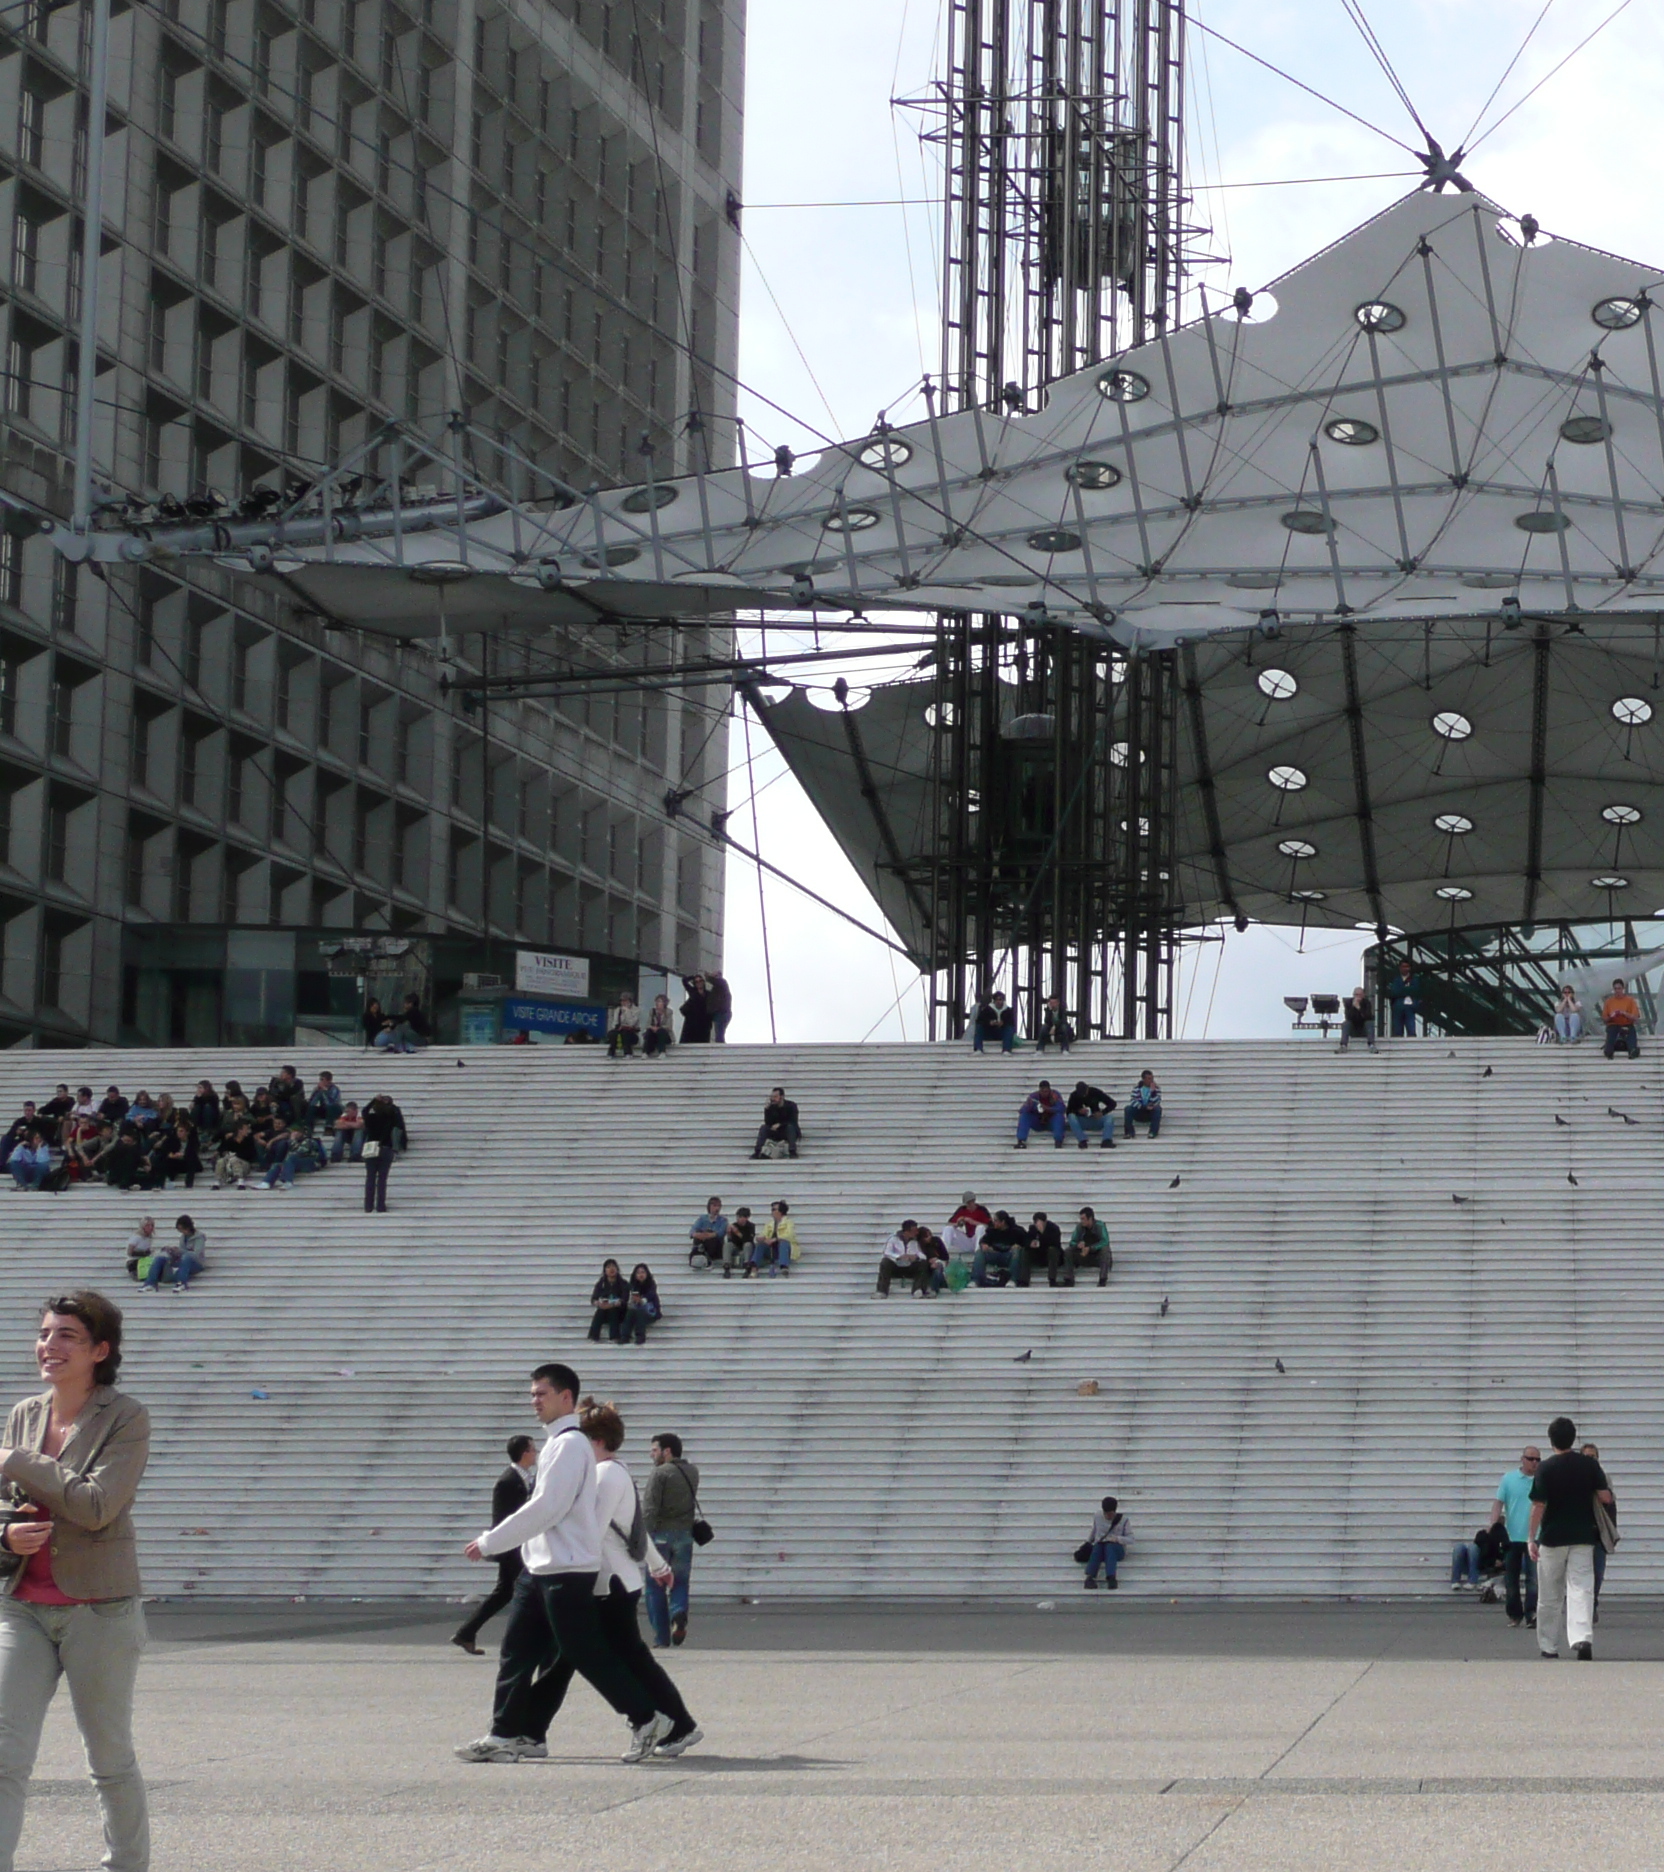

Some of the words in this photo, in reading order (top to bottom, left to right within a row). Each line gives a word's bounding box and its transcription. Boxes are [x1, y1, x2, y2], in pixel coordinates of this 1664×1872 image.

[534, 955, 572, 970] VISITE
[512, 1005, 535, 1019] VISITE
[536, 1008, 570, 1024] GRANDE
[571, 1011, 598, 1027] ARCHE
